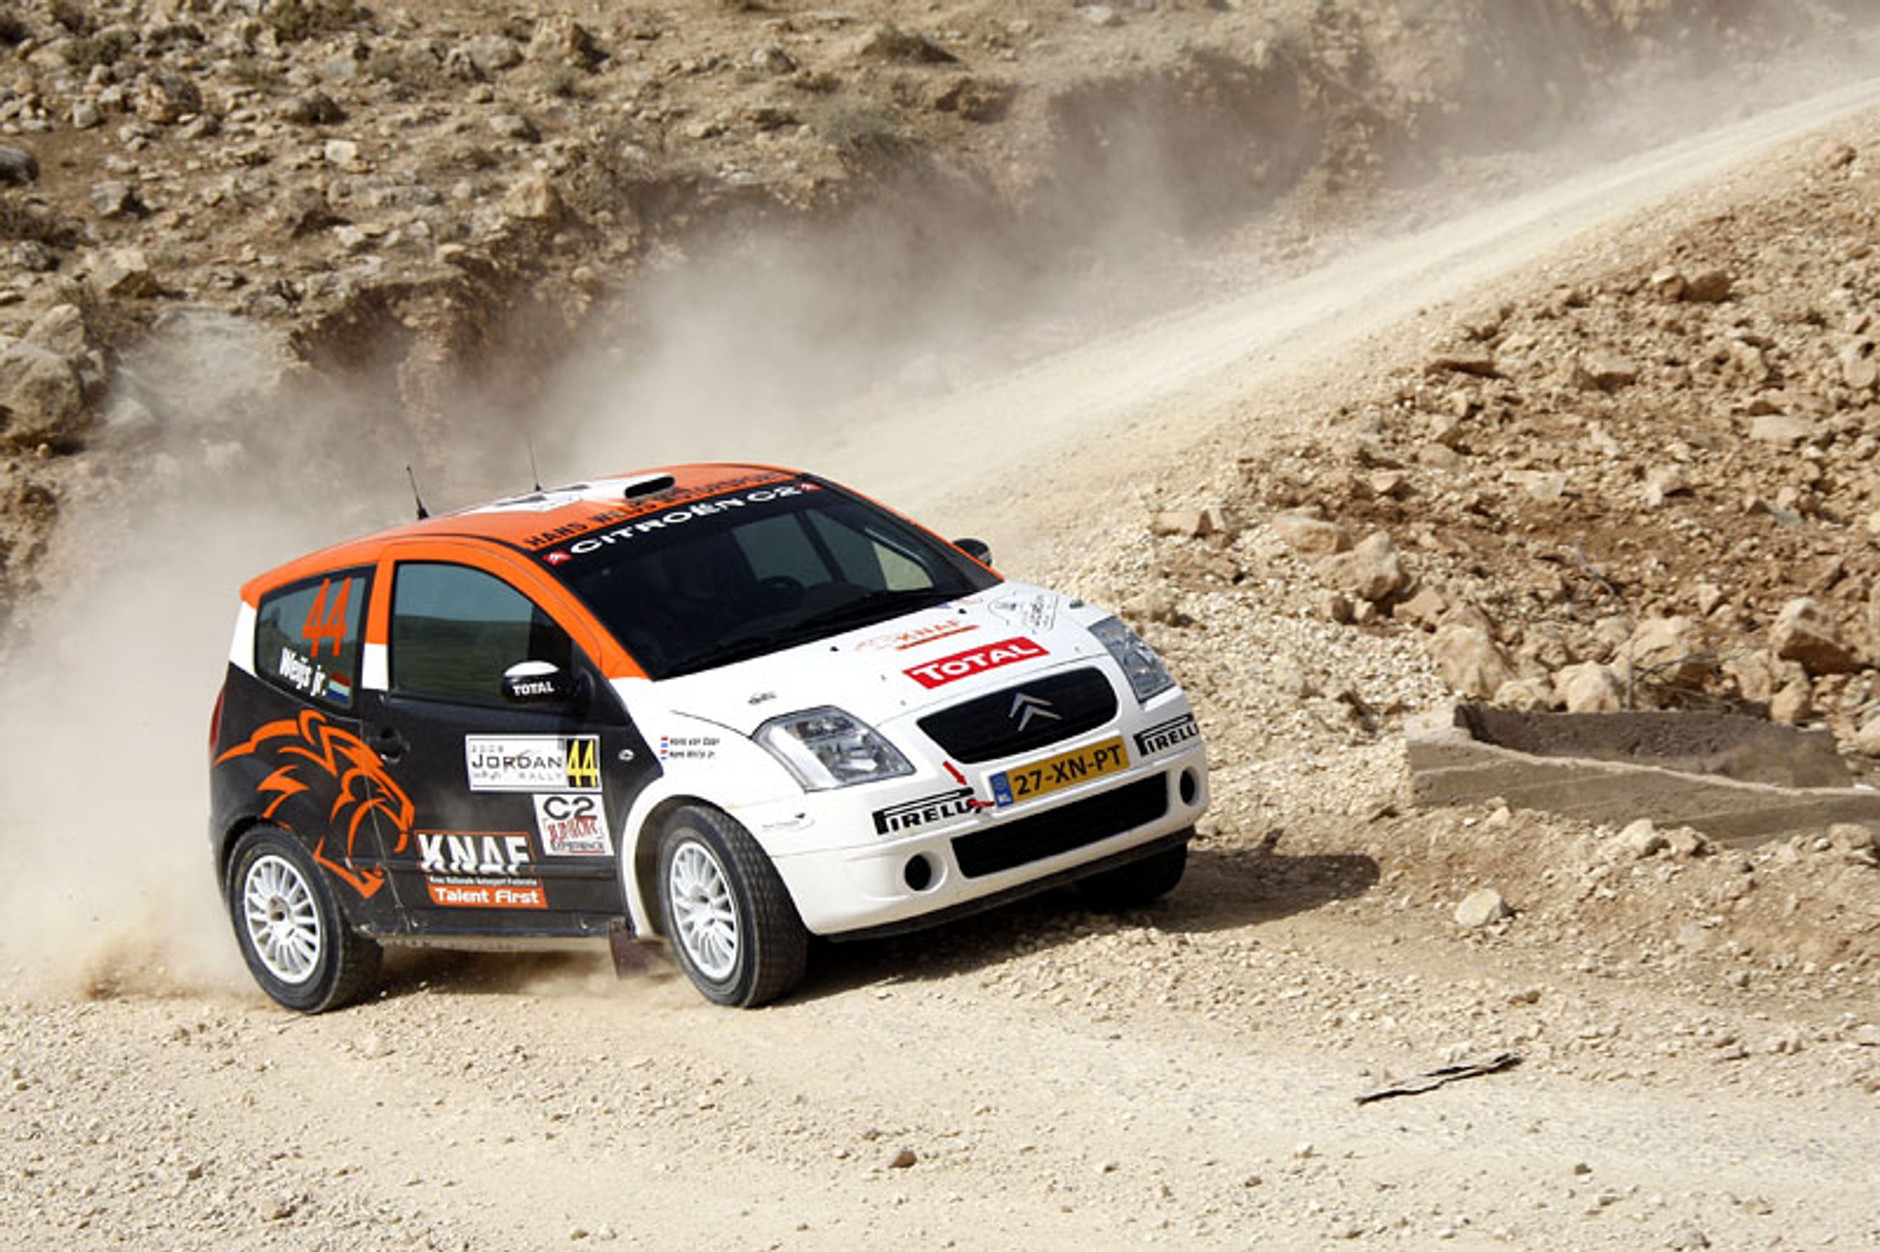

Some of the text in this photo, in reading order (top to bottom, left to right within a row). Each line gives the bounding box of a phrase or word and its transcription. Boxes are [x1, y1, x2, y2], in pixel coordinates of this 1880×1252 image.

[747, 485, 802, 502] C2
[302, 577, 352, 658] 44
[911, 644, 1040, 681] TOTAL
[512, 681, 555, 697] TOTAL
[471, 754, 562, 769] JORDAN
[566, 738, 598, 789] 44
[1013, 744, 1121, 796] 27-XN-PT
[543, 796, 597, 820] C2
[418, 834, 530, 875] KNAF
[434, 888, 540, 903] Talent First
